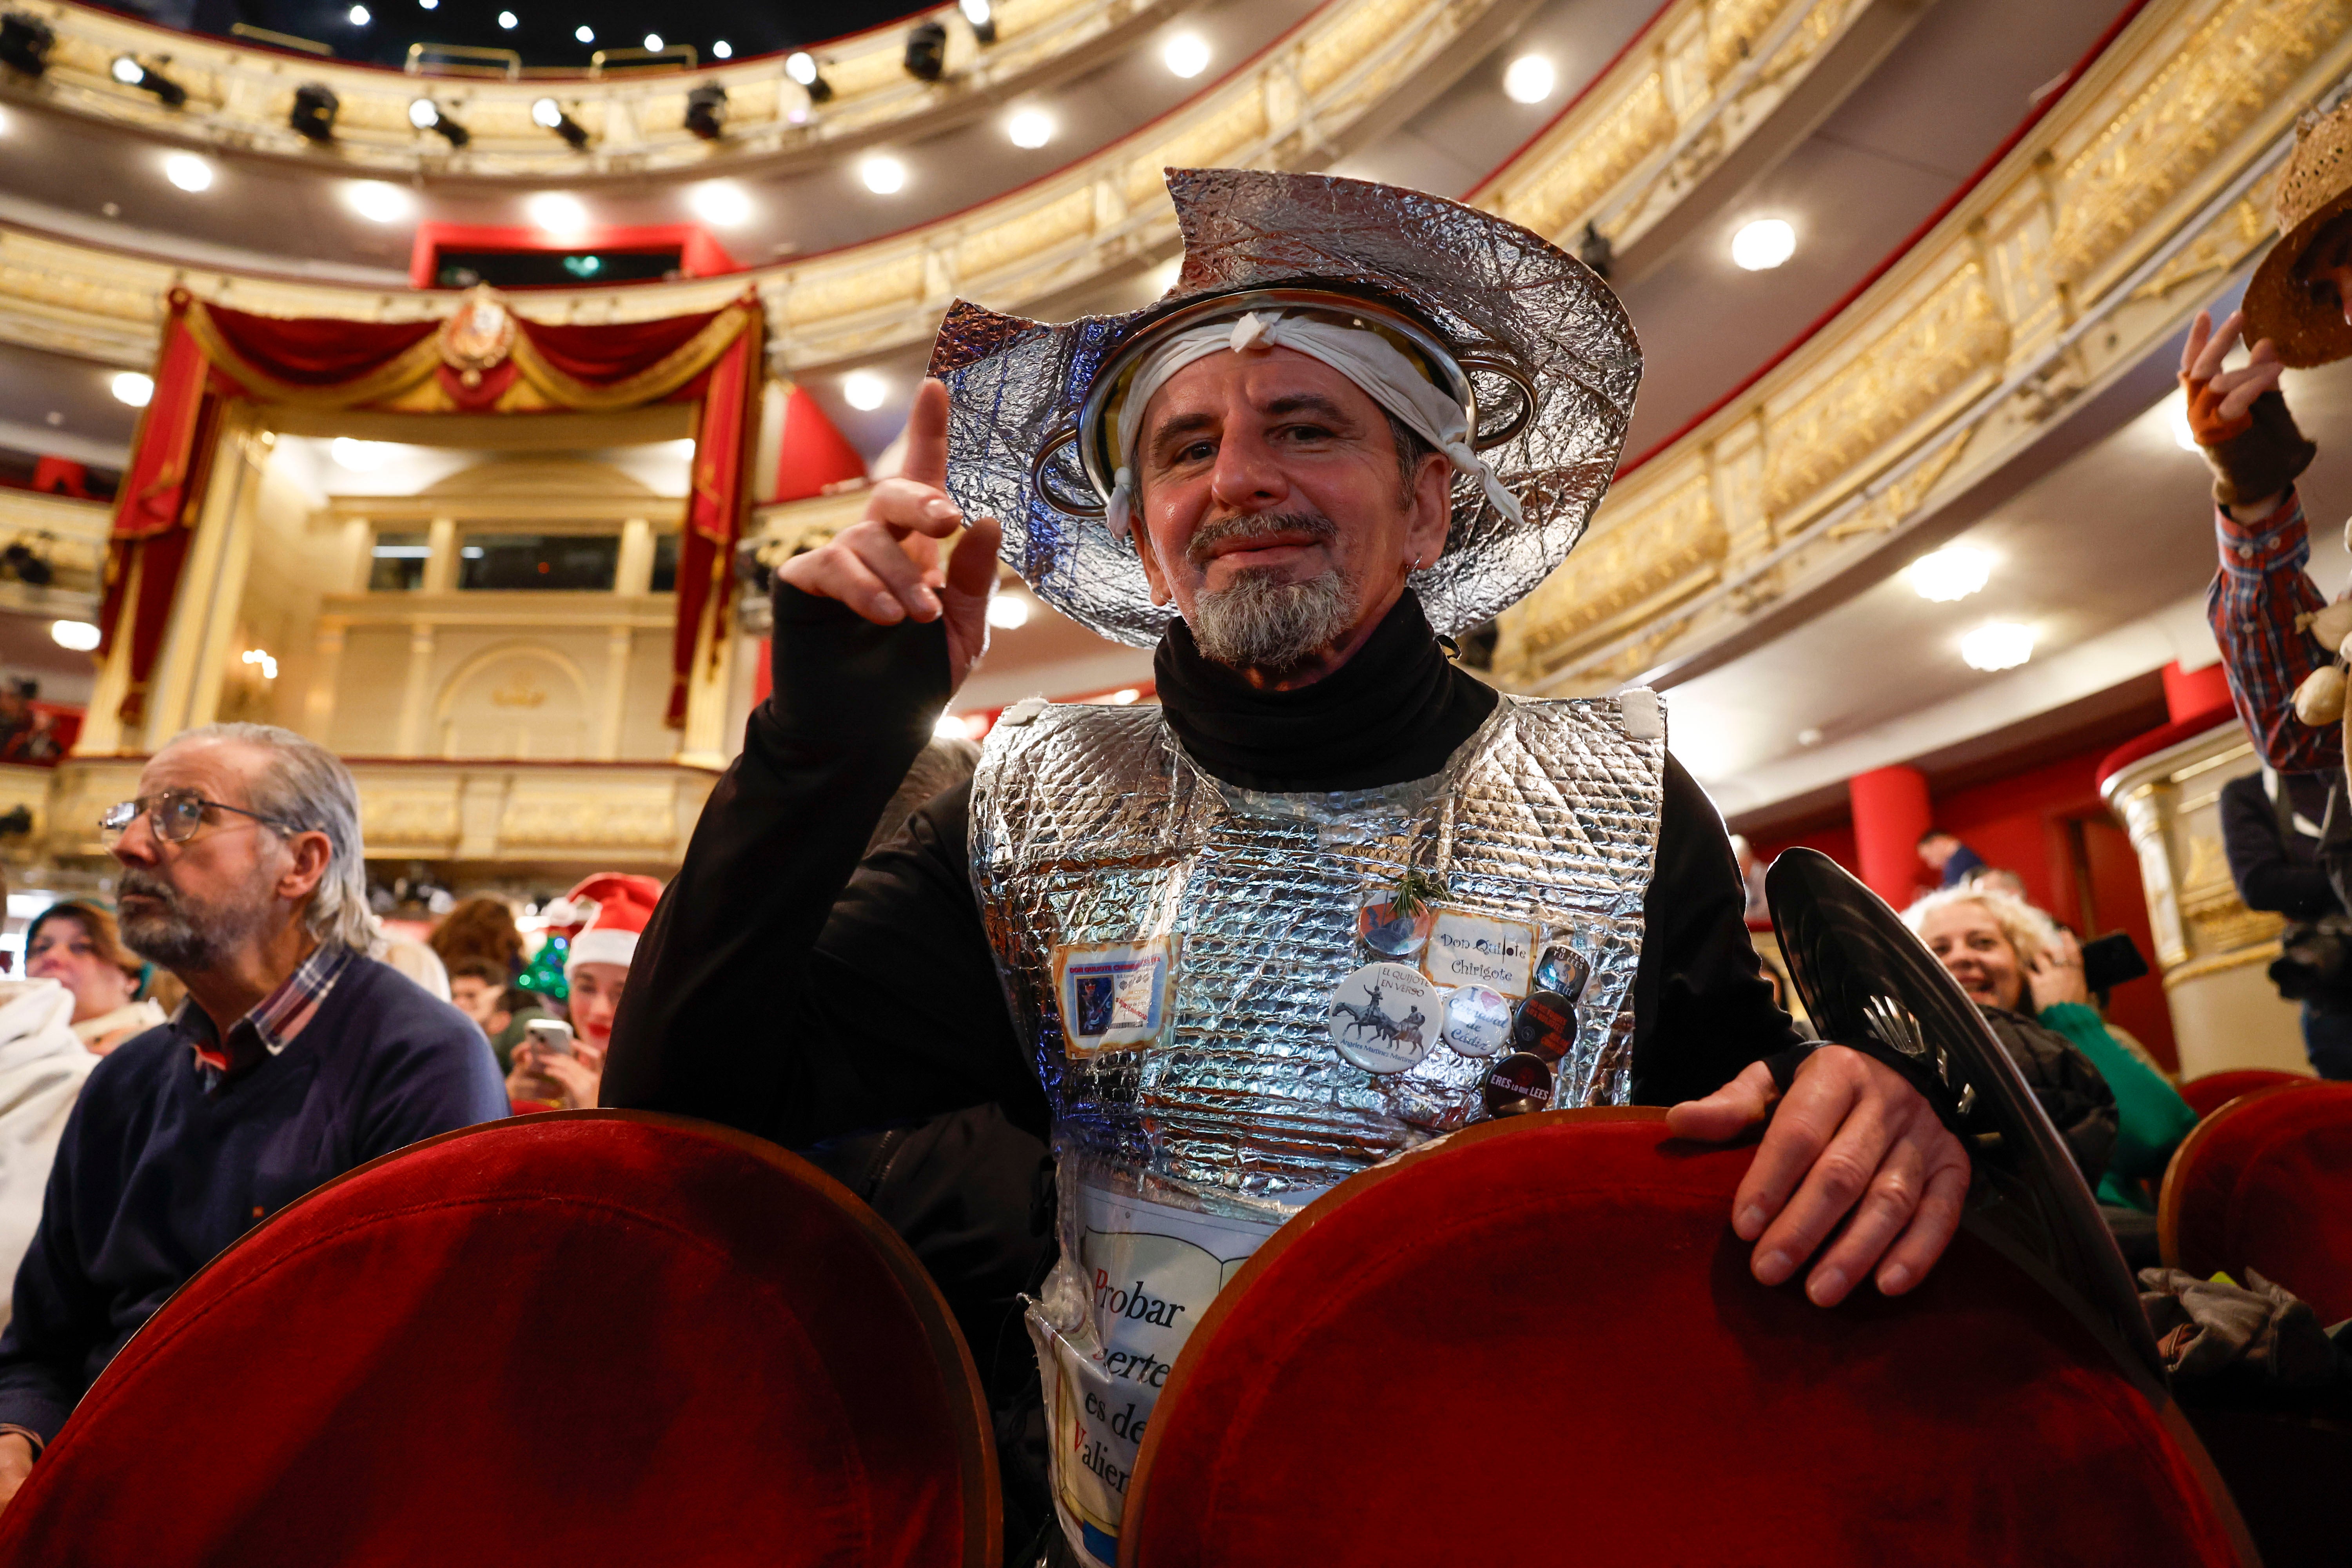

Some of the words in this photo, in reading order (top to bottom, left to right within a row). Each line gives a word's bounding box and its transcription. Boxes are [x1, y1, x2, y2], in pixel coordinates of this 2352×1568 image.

[1441, 934, 1470, 949] Don
[1567, 957, 1584, 969] LEES
[1570, 952, 1584, 963] LEO
[1383, 967, 1390, 976] EL
[1392, 971, 1429, 987] QUIJOTE
[1452, 960, 1512, 981] Chirigote
[1381, 979, 1393, 988] EN
[1396, 983, 1425, 997] VERSO
[1468, 987, 1479, 1002] I
[1466, 1022, 1481, 1032] de
[1490, 1074, 1512, 1089] ERES
[1519, 1086, 1529, 1095] QUE
[1529, 1087, 1549, 1100] LEES
[1094, 1268, 1185, 1328] Probar
[1092, 1348, 1171, 1387] erte
[1085, 1392, 1105, 1422] es
[1112, 1403, 1147, 1445] de
